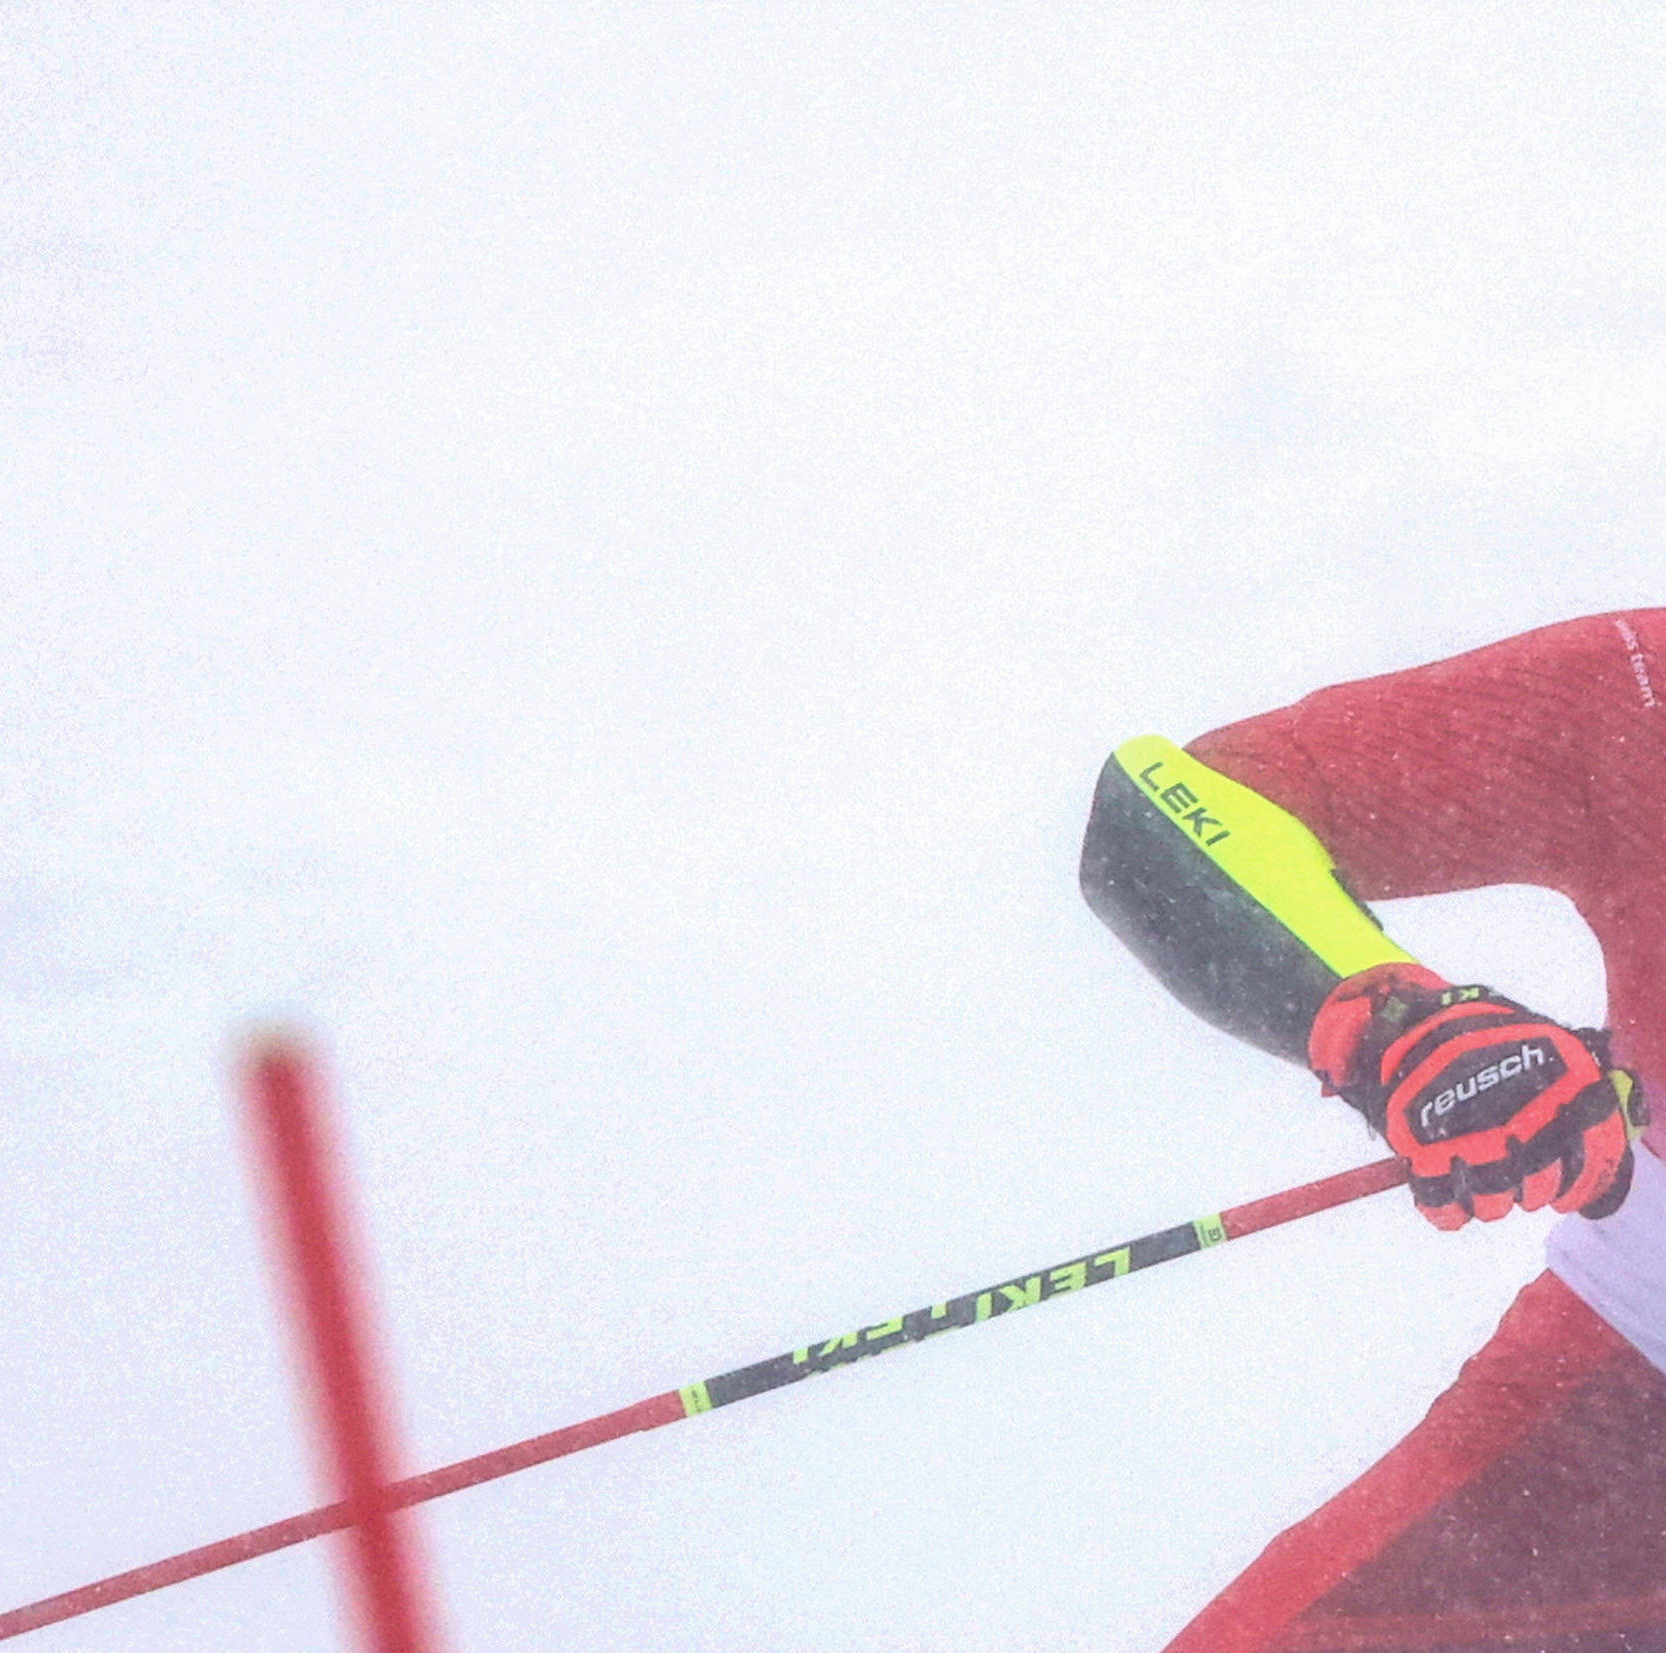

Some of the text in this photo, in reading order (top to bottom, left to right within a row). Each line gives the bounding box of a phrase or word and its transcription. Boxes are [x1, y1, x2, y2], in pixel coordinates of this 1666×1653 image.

[1139, 761, 1231, 847] LEKI
[1419, 1043, 1545, 1128] reusch
[975, 1246, 1131, 1323] LEKI
